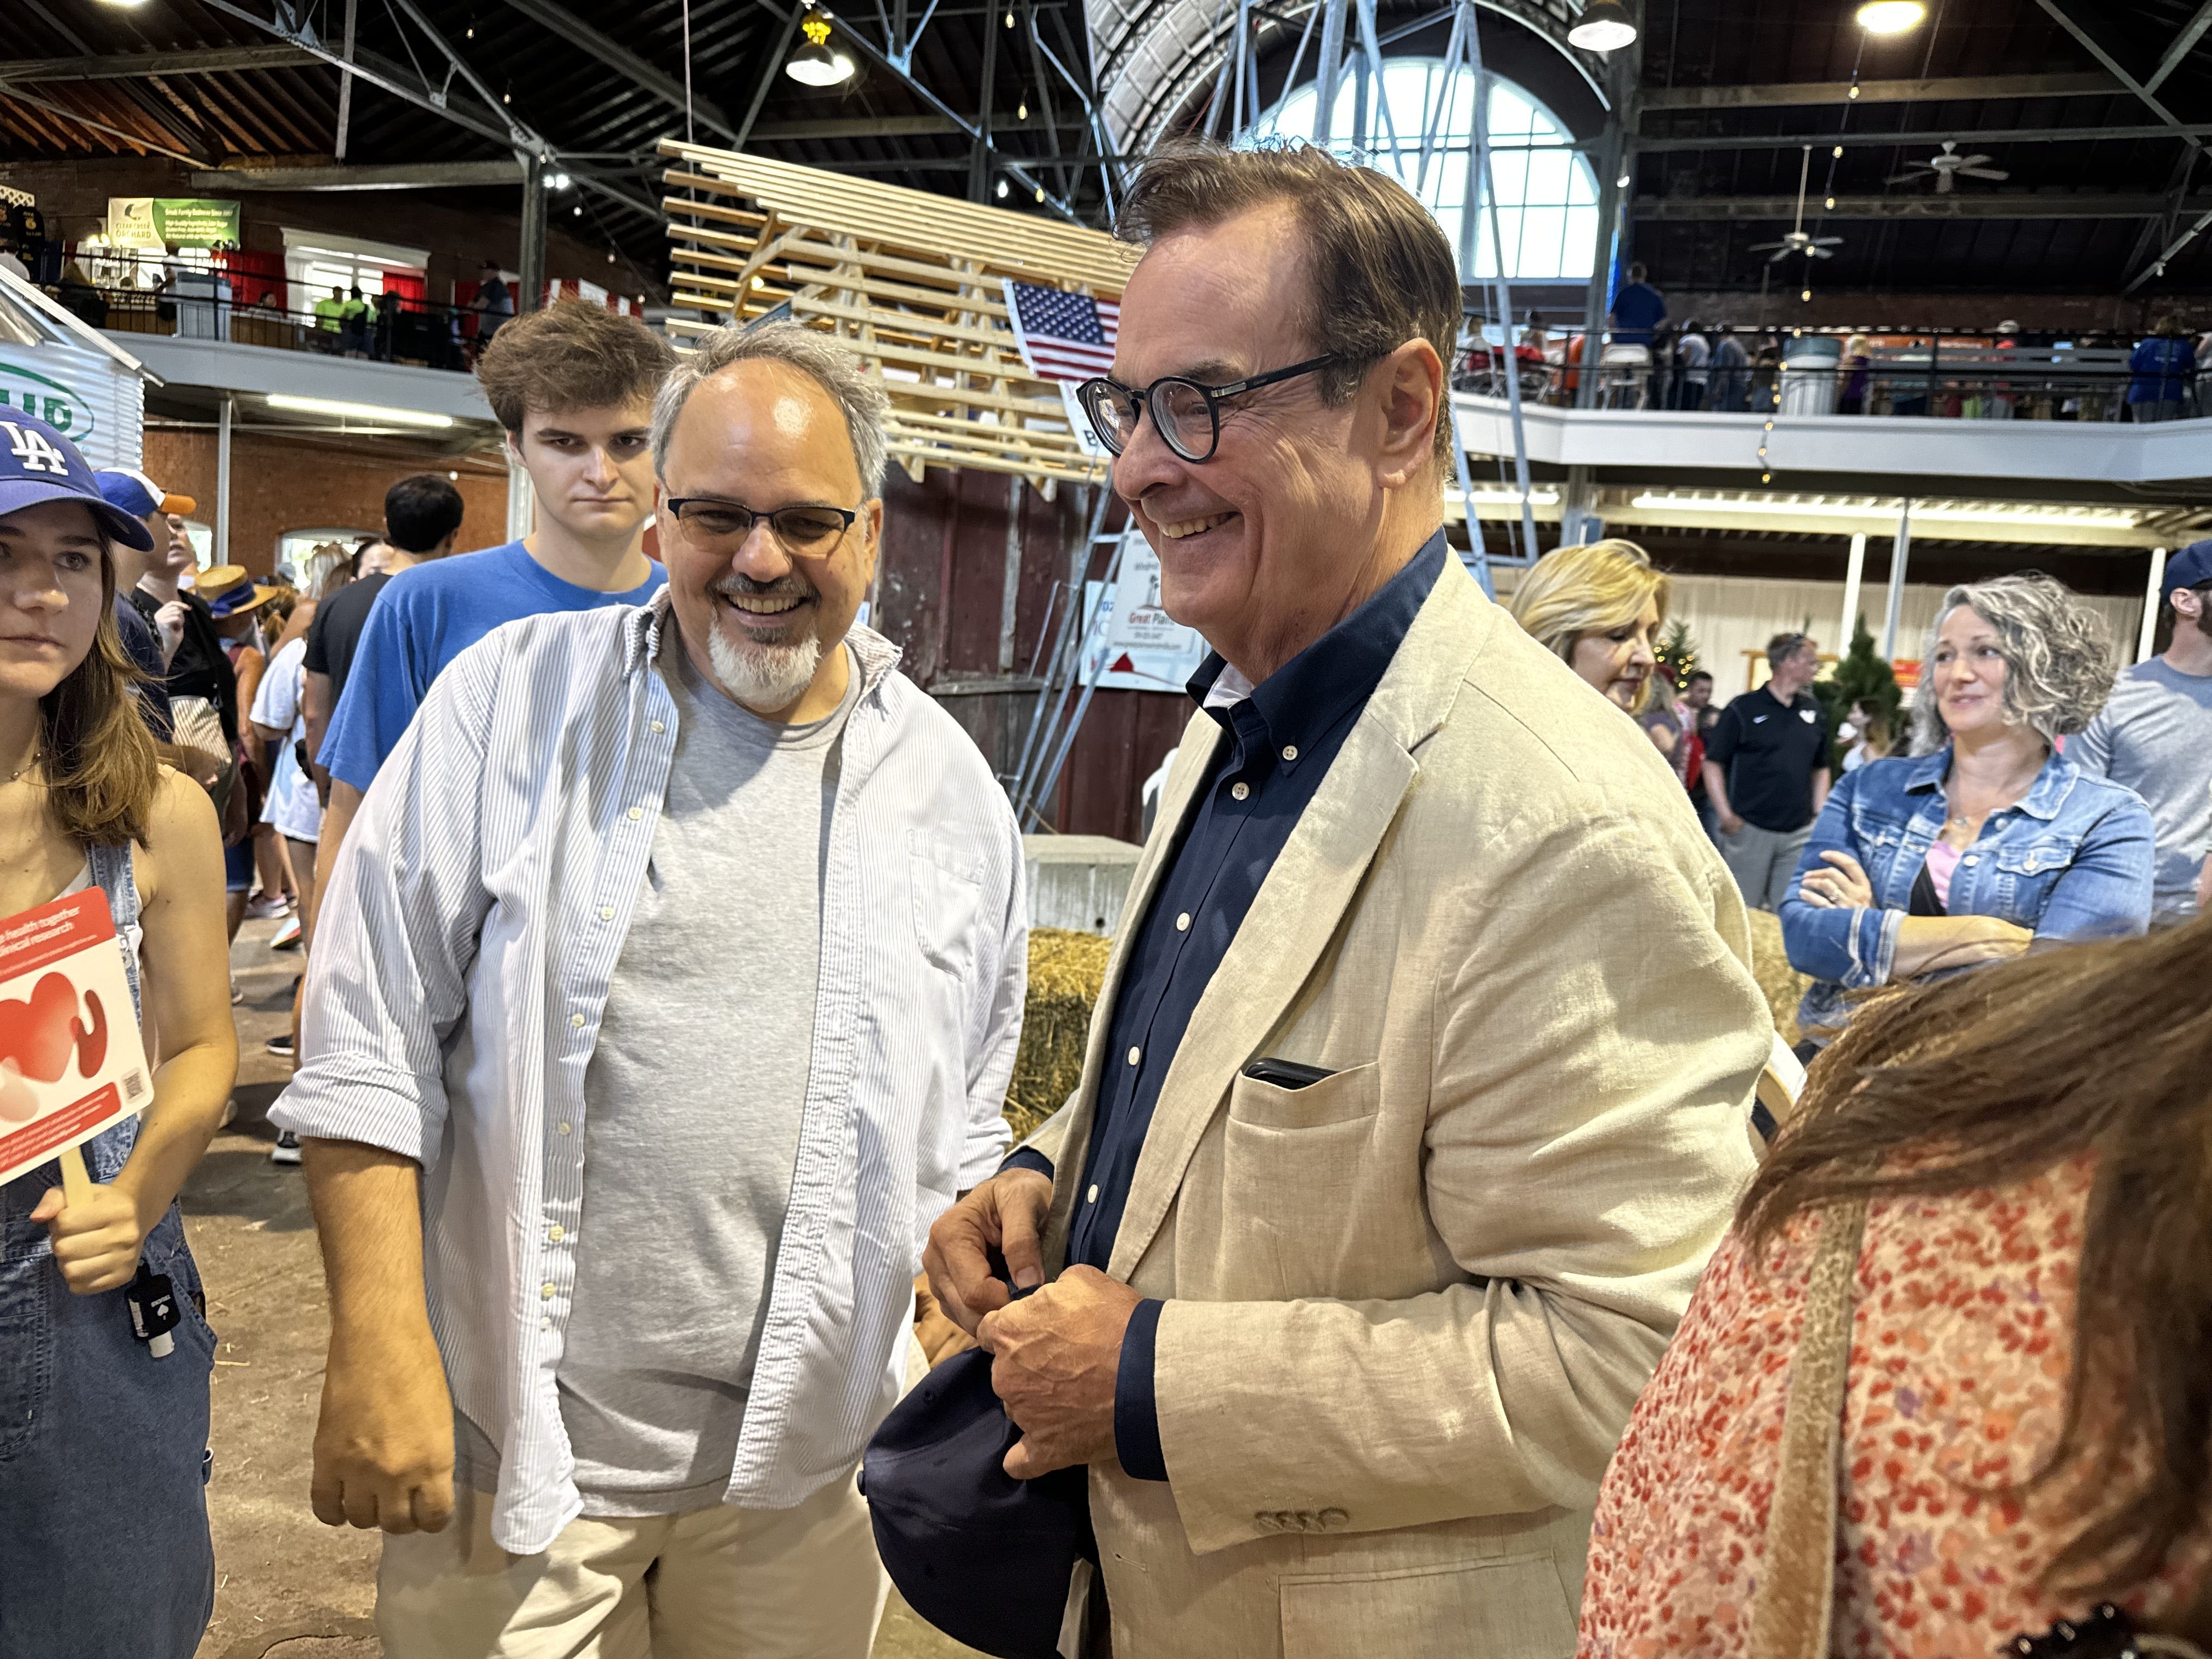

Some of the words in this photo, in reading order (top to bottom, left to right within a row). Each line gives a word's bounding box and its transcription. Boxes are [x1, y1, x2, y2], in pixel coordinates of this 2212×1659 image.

[116, 230, 151, 239] ORCHARD
[0, 421, 69, 476] LA
[1129, 613, 1151, 624] Great
[4, 921, 40, 940] health
[39, 906, 81, 928] together
[30, 921, 75, 945] research
